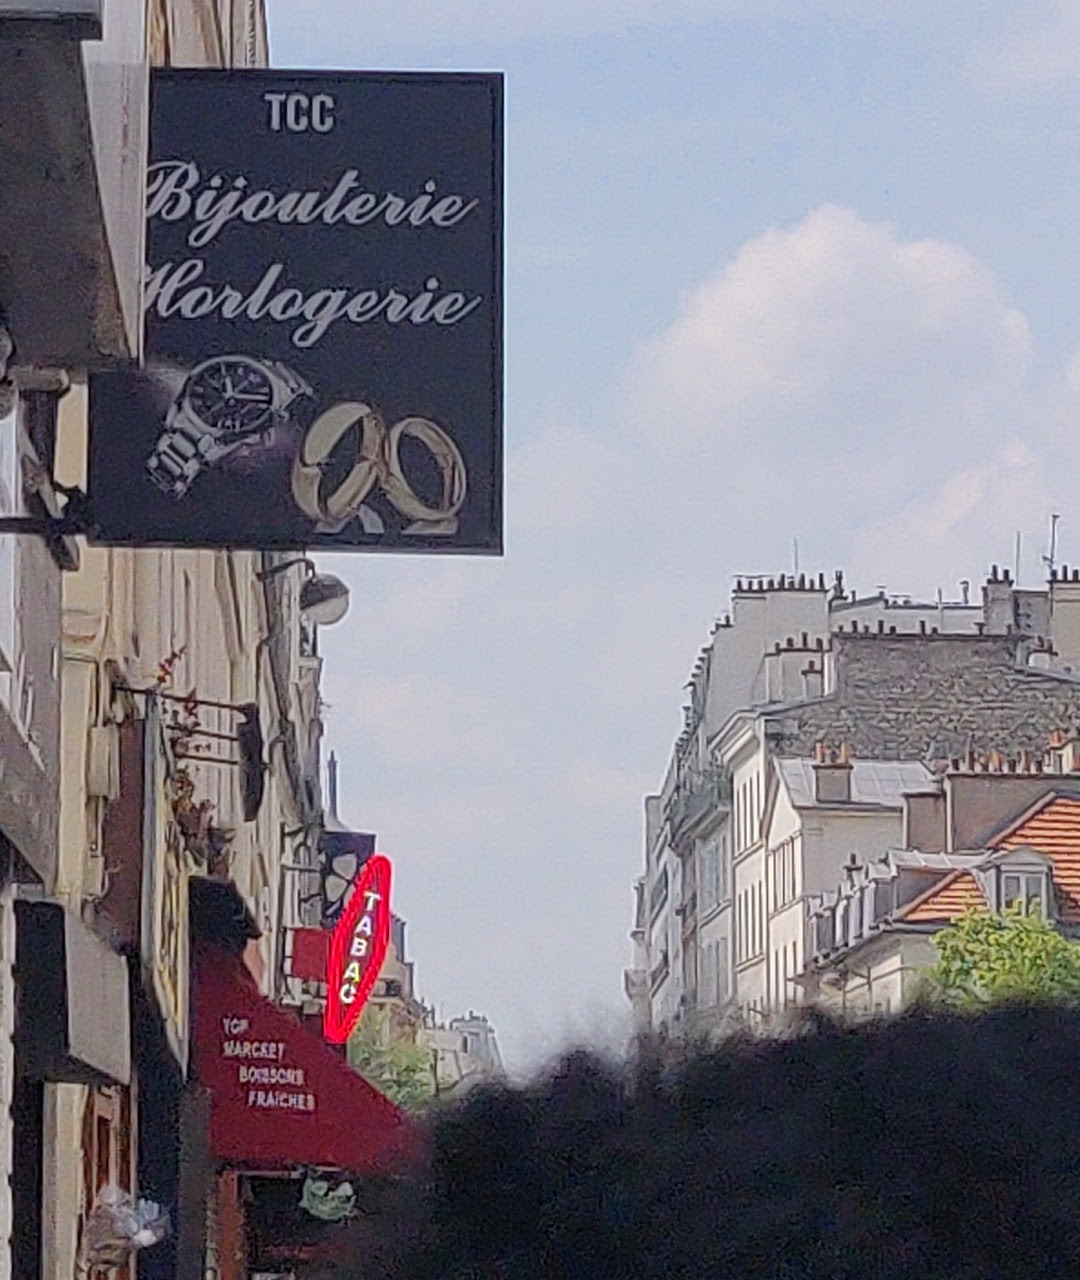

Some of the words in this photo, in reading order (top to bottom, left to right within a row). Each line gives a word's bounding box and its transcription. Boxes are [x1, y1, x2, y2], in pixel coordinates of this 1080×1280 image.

[264, 92, 337, 133] TCC
[145, 159, 479, 248] Bijouterie
[143, 258, 481, 348] Horlogerie
[339, 891, 382, 1005] TABAC
